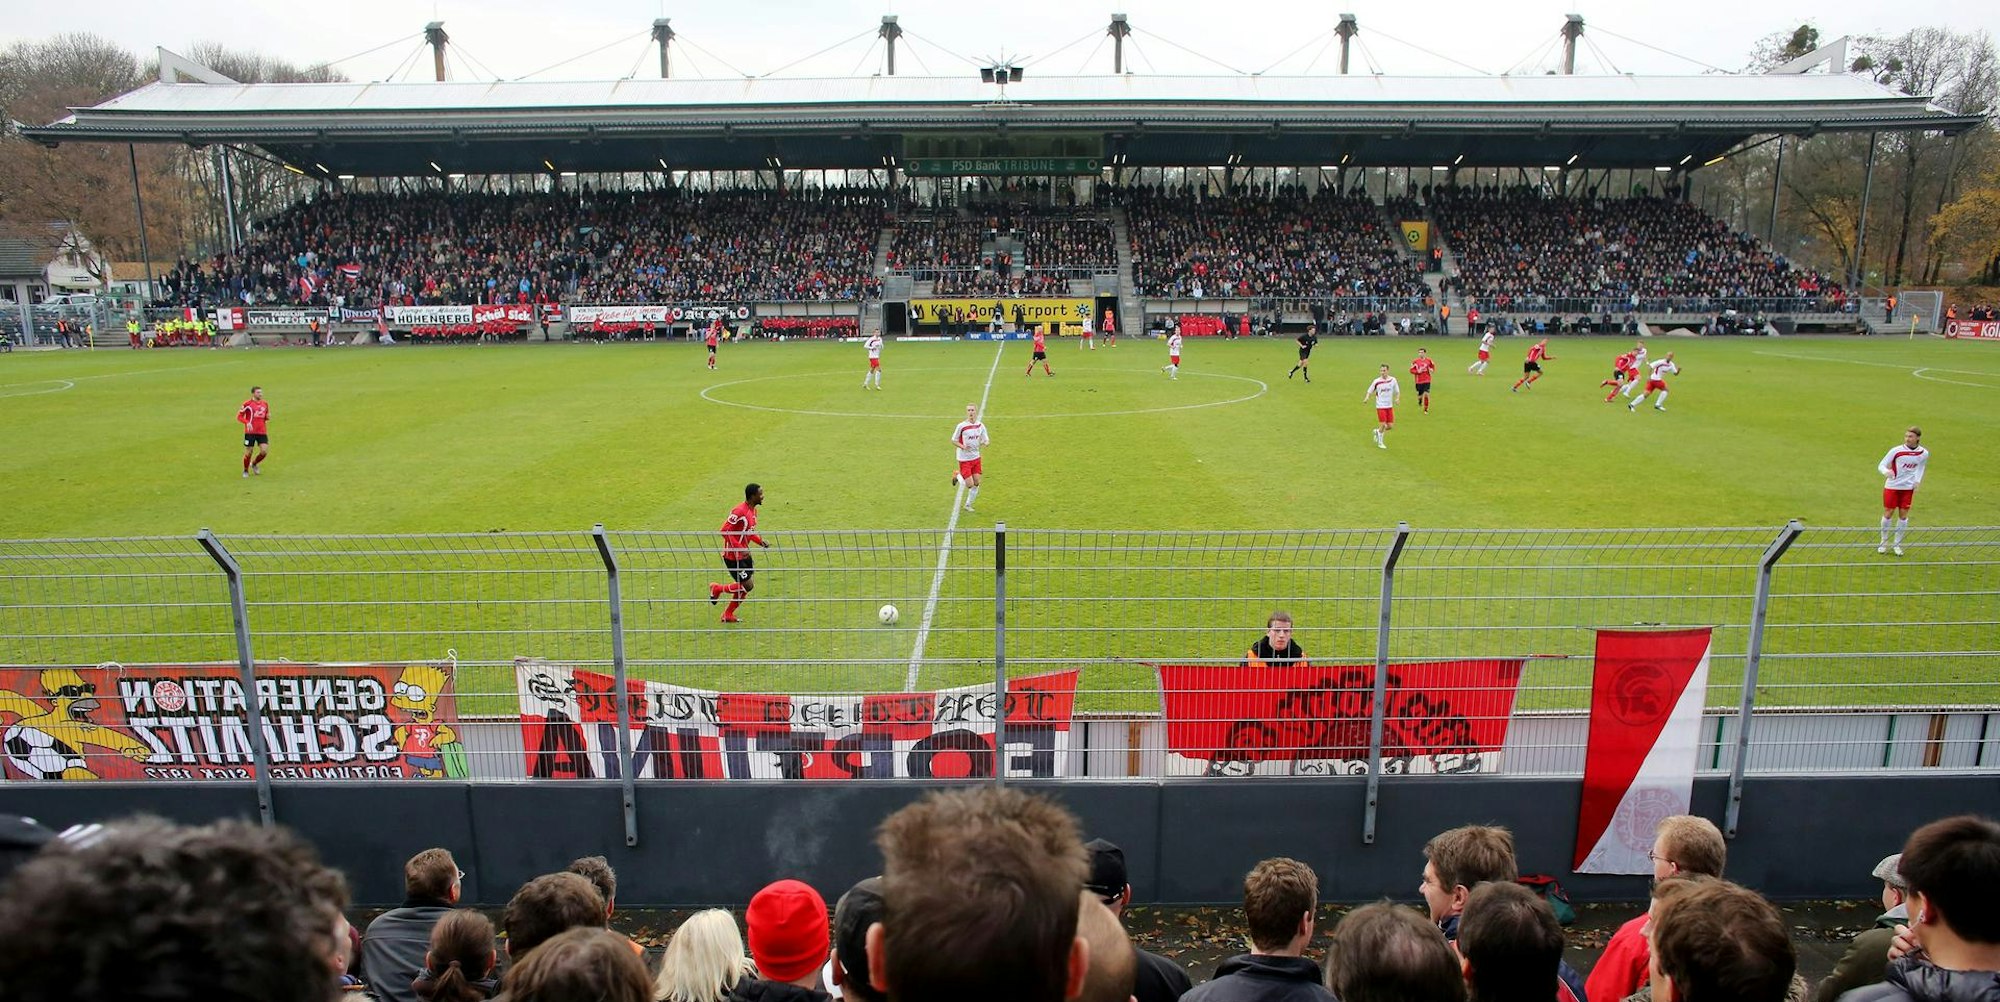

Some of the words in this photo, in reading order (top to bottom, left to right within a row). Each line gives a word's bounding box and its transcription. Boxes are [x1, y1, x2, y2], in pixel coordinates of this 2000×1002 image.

[952, 161, 973, 171] PSD
[976, 161, 1001, 171] Bank
[1012, 304, 1068, 319] Airport
